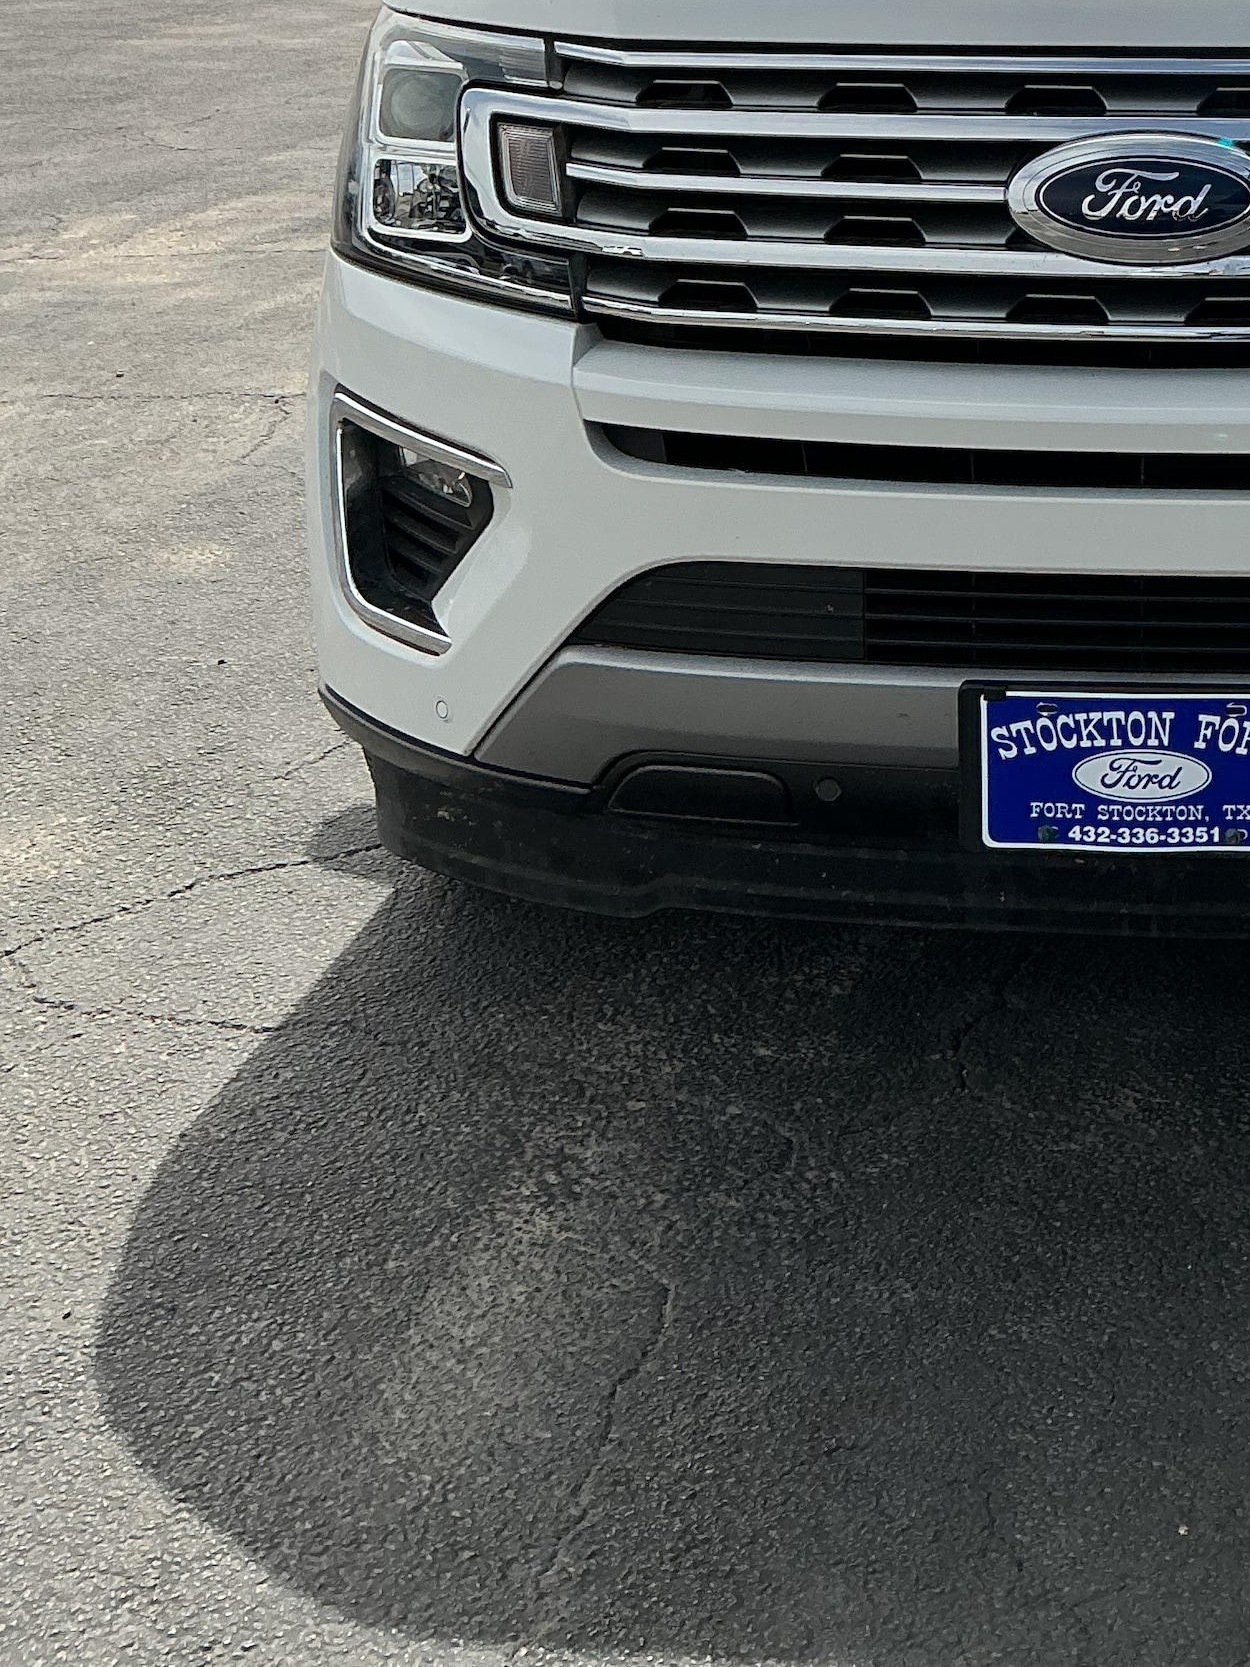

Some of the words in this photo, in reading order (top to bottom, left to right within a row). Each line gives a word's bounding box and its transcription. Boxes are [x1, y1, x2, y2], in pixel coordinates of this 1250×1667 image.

[1081, 167, 1213, 222] Ford
[990, 710, 1175, 760] STOCKTON
[1099, 757, 1184, 791] Ford
[1030, 802, 1086, 819] FORT
[1096, 804, 1210, 822] STOCKTON,
[1067, 825, 1220, 844] 432-336-3351
